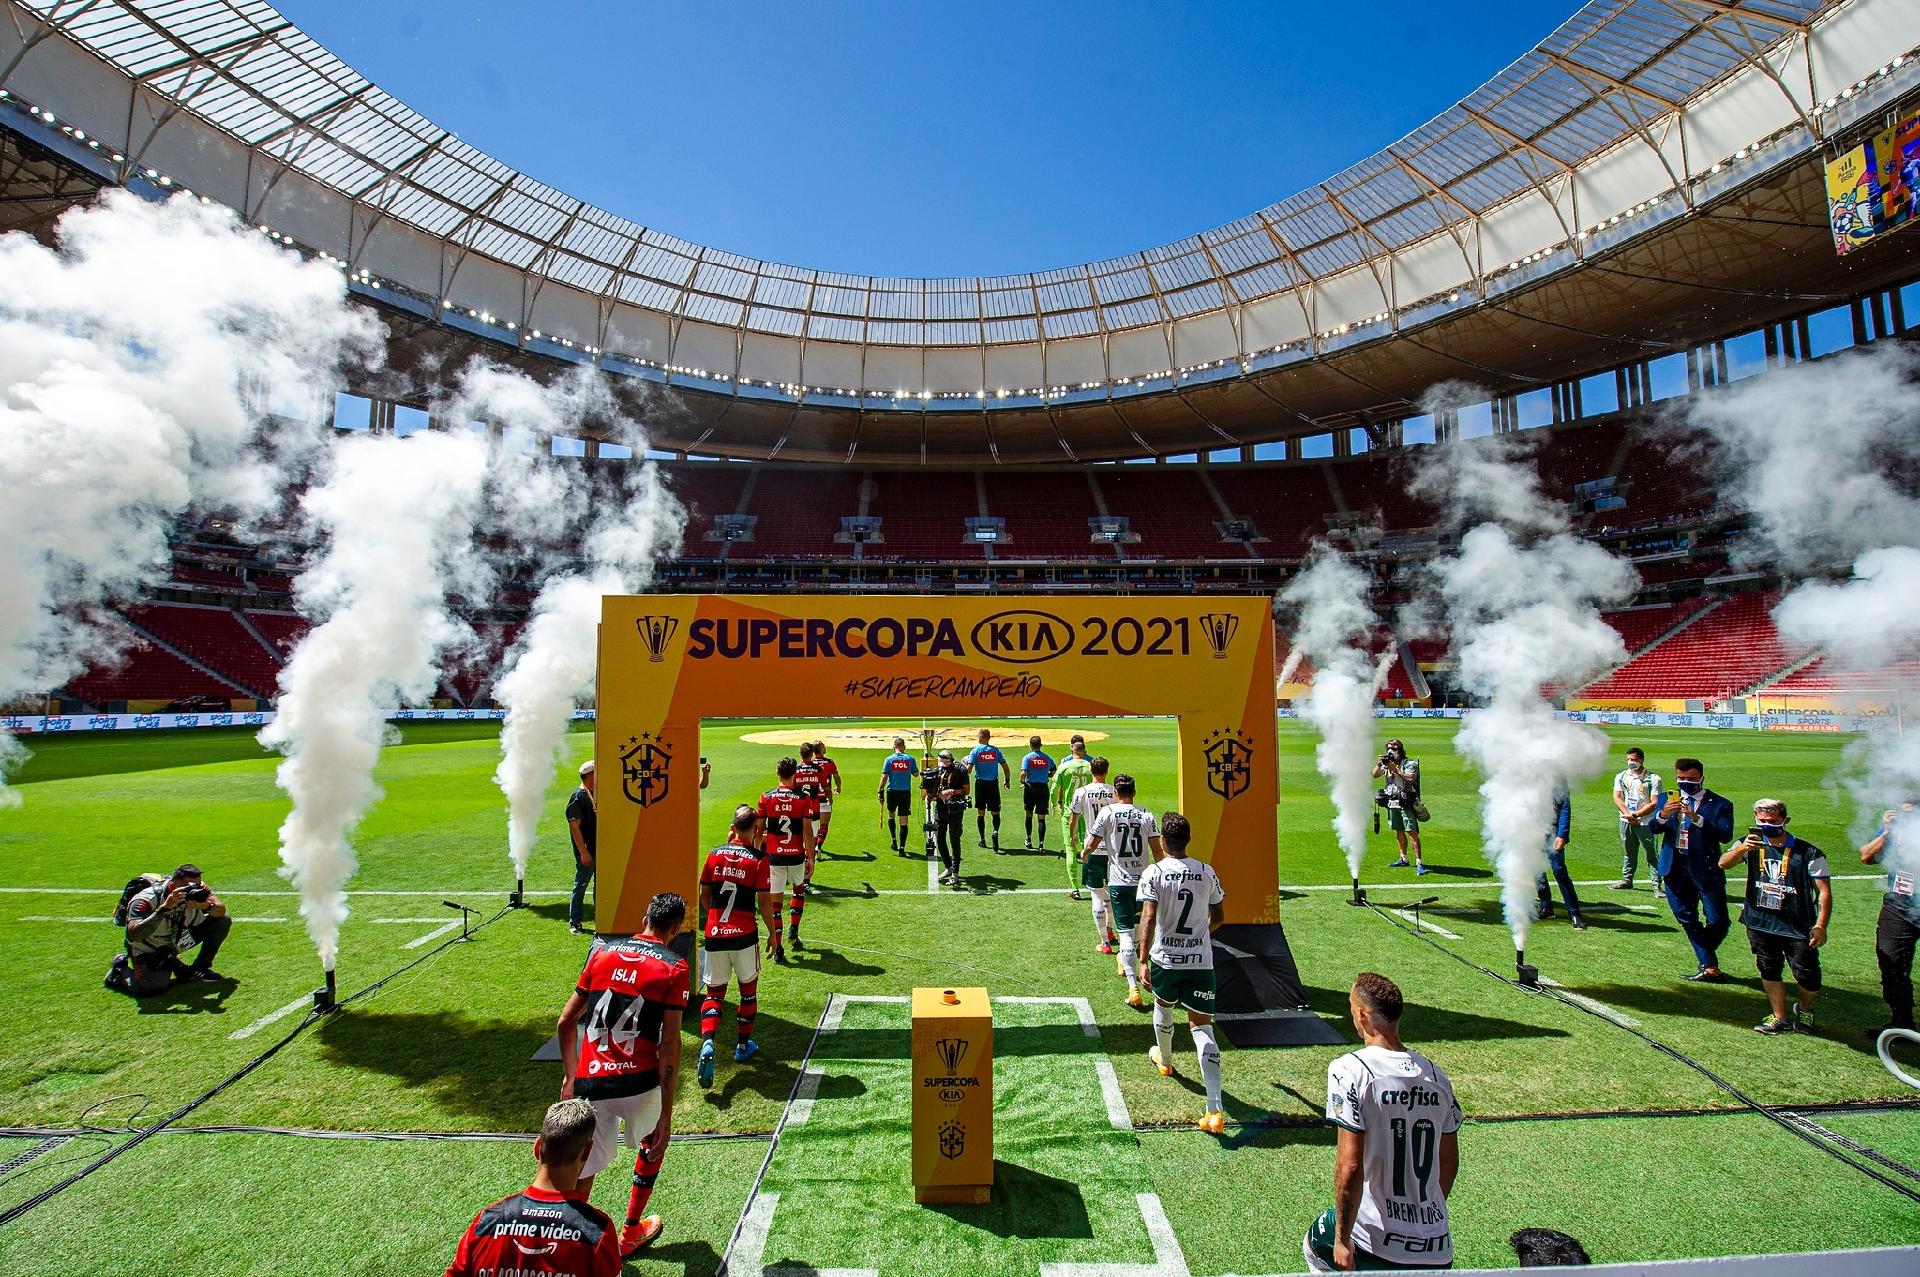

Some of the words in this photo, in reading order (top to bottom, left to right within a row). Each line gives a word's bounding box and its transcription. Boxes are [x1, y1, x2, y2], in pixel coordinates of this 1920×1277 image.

[688, 617, 966, 661] SUPERCOPA
[990, 622, 1061, 652] KIA
[1081, 617, 1190, 656] 2021
[844, 671, 1042, 700] #SUPERCAMPEÃO
[1219, 763, 1239, 772] CBF
[1087, 789, 1113, 800] crefisa
[778, 815, 793, 845] 3
[1118, 822, 1143, 858] 23
[735, 850, 754, 860] video
[1165, 870, 1203, 884] crefisa
[719, 880, 738, 923] 7
[1175, 888, 1194, 935] 2
[719, 927, 743, 935] TOTAL
[608, 943, 636, 954] prime
[636, 948, 662, 960] video
[611, 968, 638, 985] ISLA
[586, 988, 645, 1057] 44
[602, 1061, 638, 1071] TOTAL
[924, 1077, 980, 1088] SUPERCOPA
[943, 1090, 961, 1099] KIA
[1381, 1085, 1440, 1111] crefisa
[1390, 1118, 1435, 1203] 19
[522, 1206, 563, 1220] amazon
[494, 1219, 538, 1240] prime
[540, 1223, 582, 1242] video
